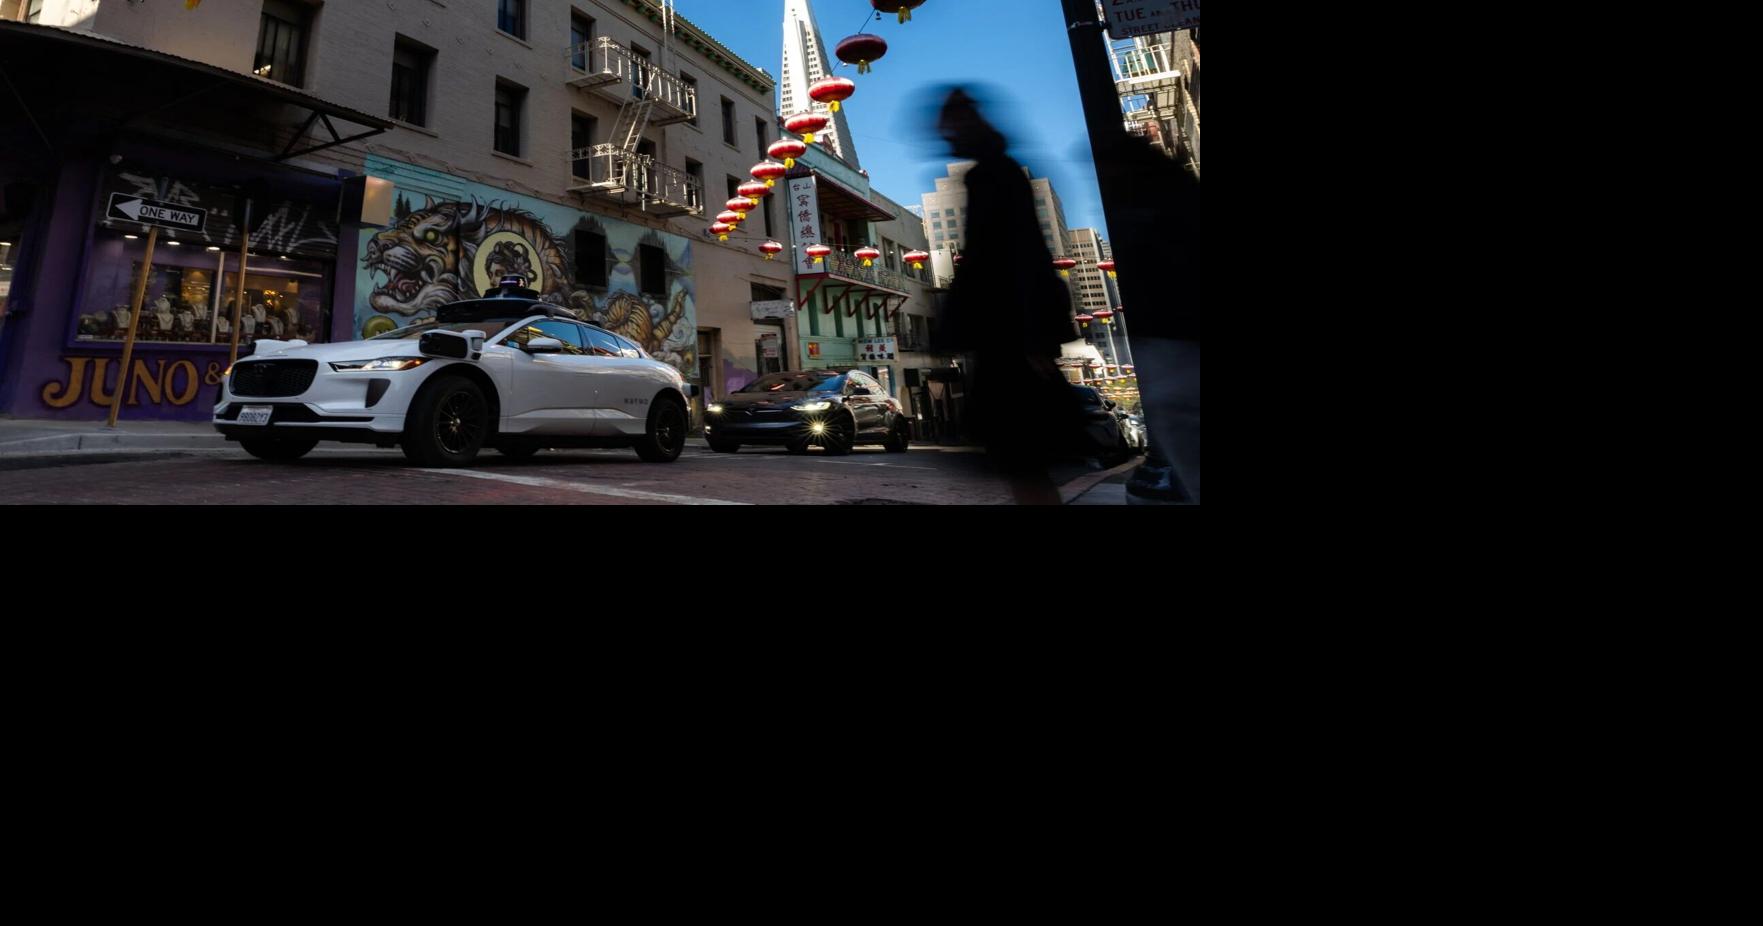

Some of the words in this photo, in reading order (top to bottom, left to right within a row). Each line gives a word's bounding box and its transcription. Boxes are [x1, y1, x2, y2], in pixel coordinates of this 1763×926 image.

[1114, 8, 1146, 22] TUE
[1120, 23, 1159, 35] STREET
[139, 206, 166, 219] ONE
[170, 211, 195, 224] WAY
[41, 357, 199, 408] JUNO
[204, 362, 223, 385] &
